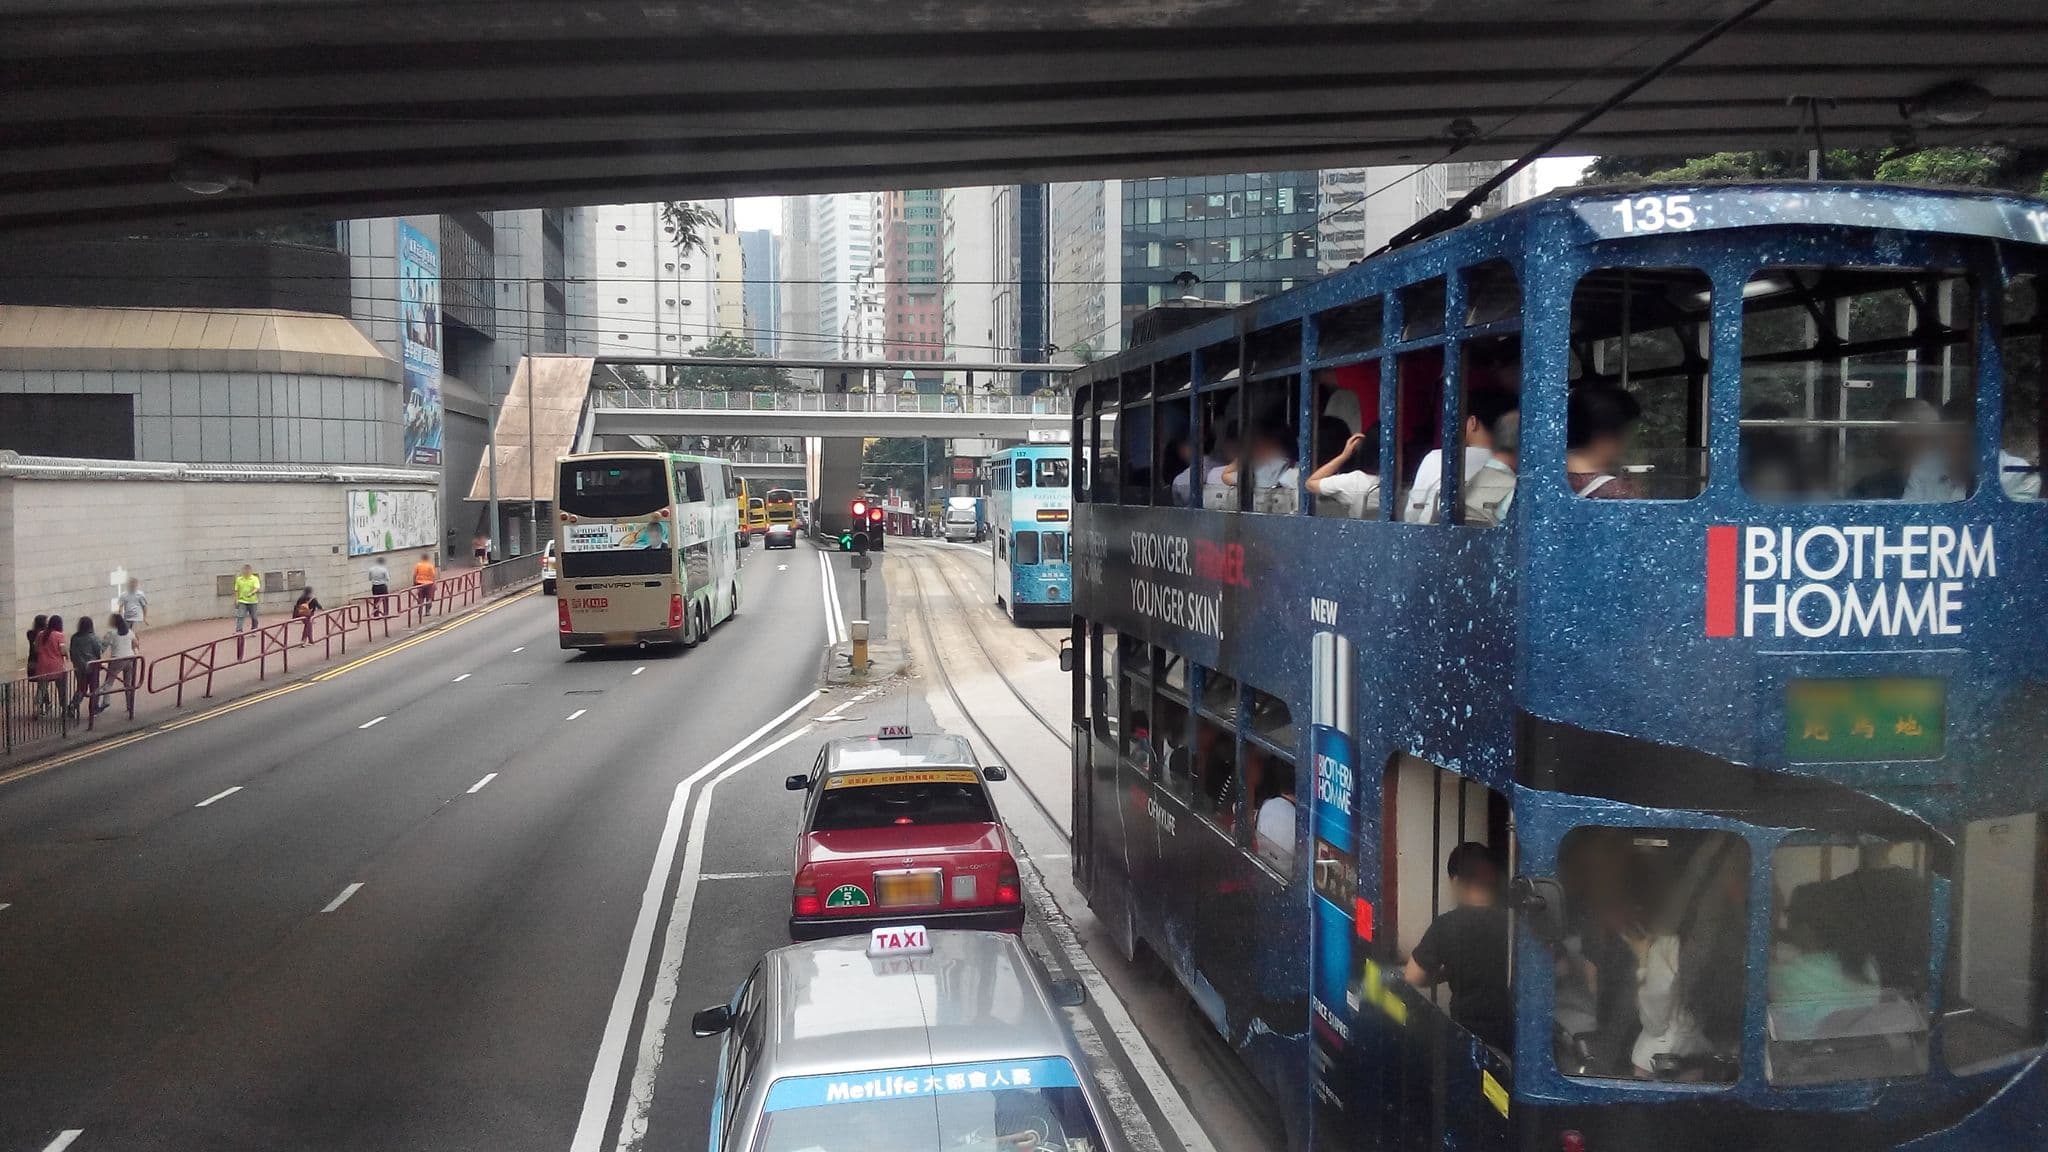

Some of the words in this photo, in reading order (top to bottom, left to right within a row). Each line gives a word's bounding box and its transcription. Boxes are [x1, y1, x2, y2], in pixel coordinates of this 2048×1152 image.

[1612, 195, 1695, 233] 135
[1130, 530, 1192, 576] STRONGER.
[1745, 524, 1997, 581] BIOTHERM
[582, 598, 608, 609] KMB
[1130, 577, 1185, 628] YOUNGER
[1311, 596, 1338, 626] NEW
[1743, 582, 1964, 638] HOMME
[882, 726, 909, 736] TAXI
[1318, 776, 1351, 816] HOMME
[843, 891, 852, 901] 5
[876, 931, 925, 949] TAXI
[826, 1075, 919, 1101] MetLife
